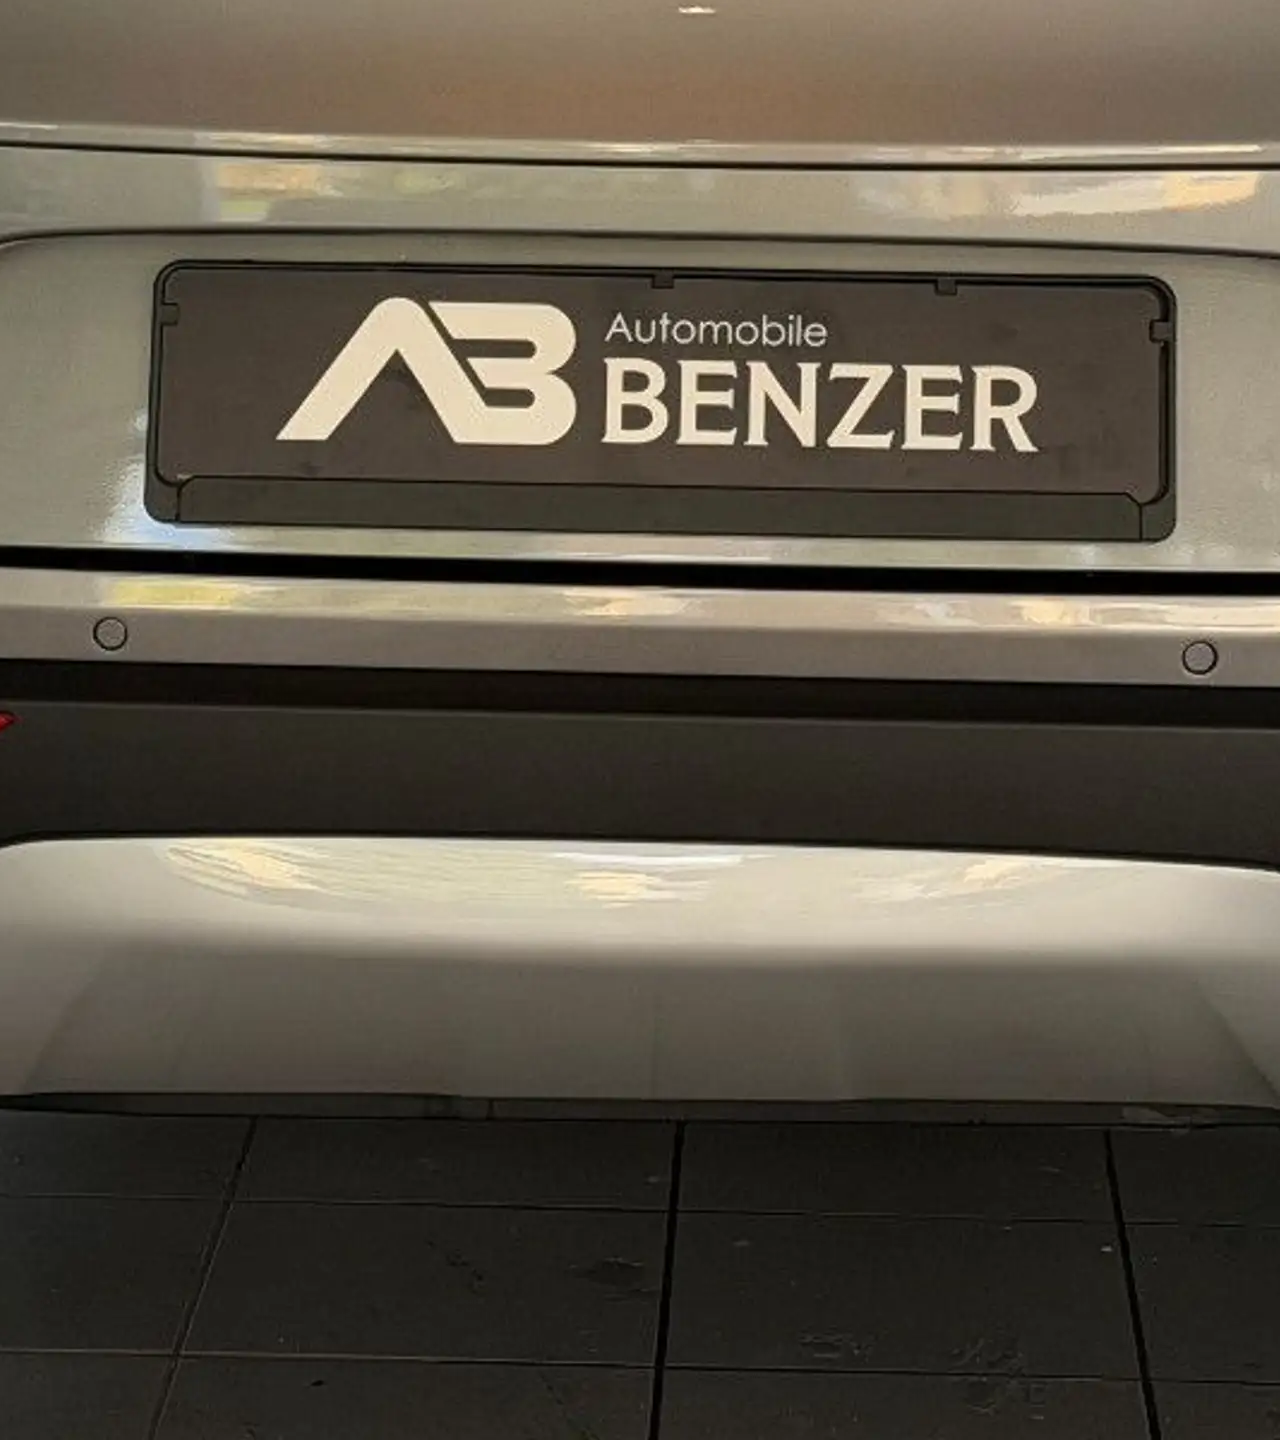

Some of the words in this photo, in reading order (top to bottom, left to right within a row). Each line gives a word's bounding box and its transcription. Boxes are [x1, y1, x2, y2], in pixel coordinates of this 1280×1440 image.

[276, 297, 577, 445] AB
[604, 312, 828, 348] Automobile
[601, 357, 1039, 452] BENZER
